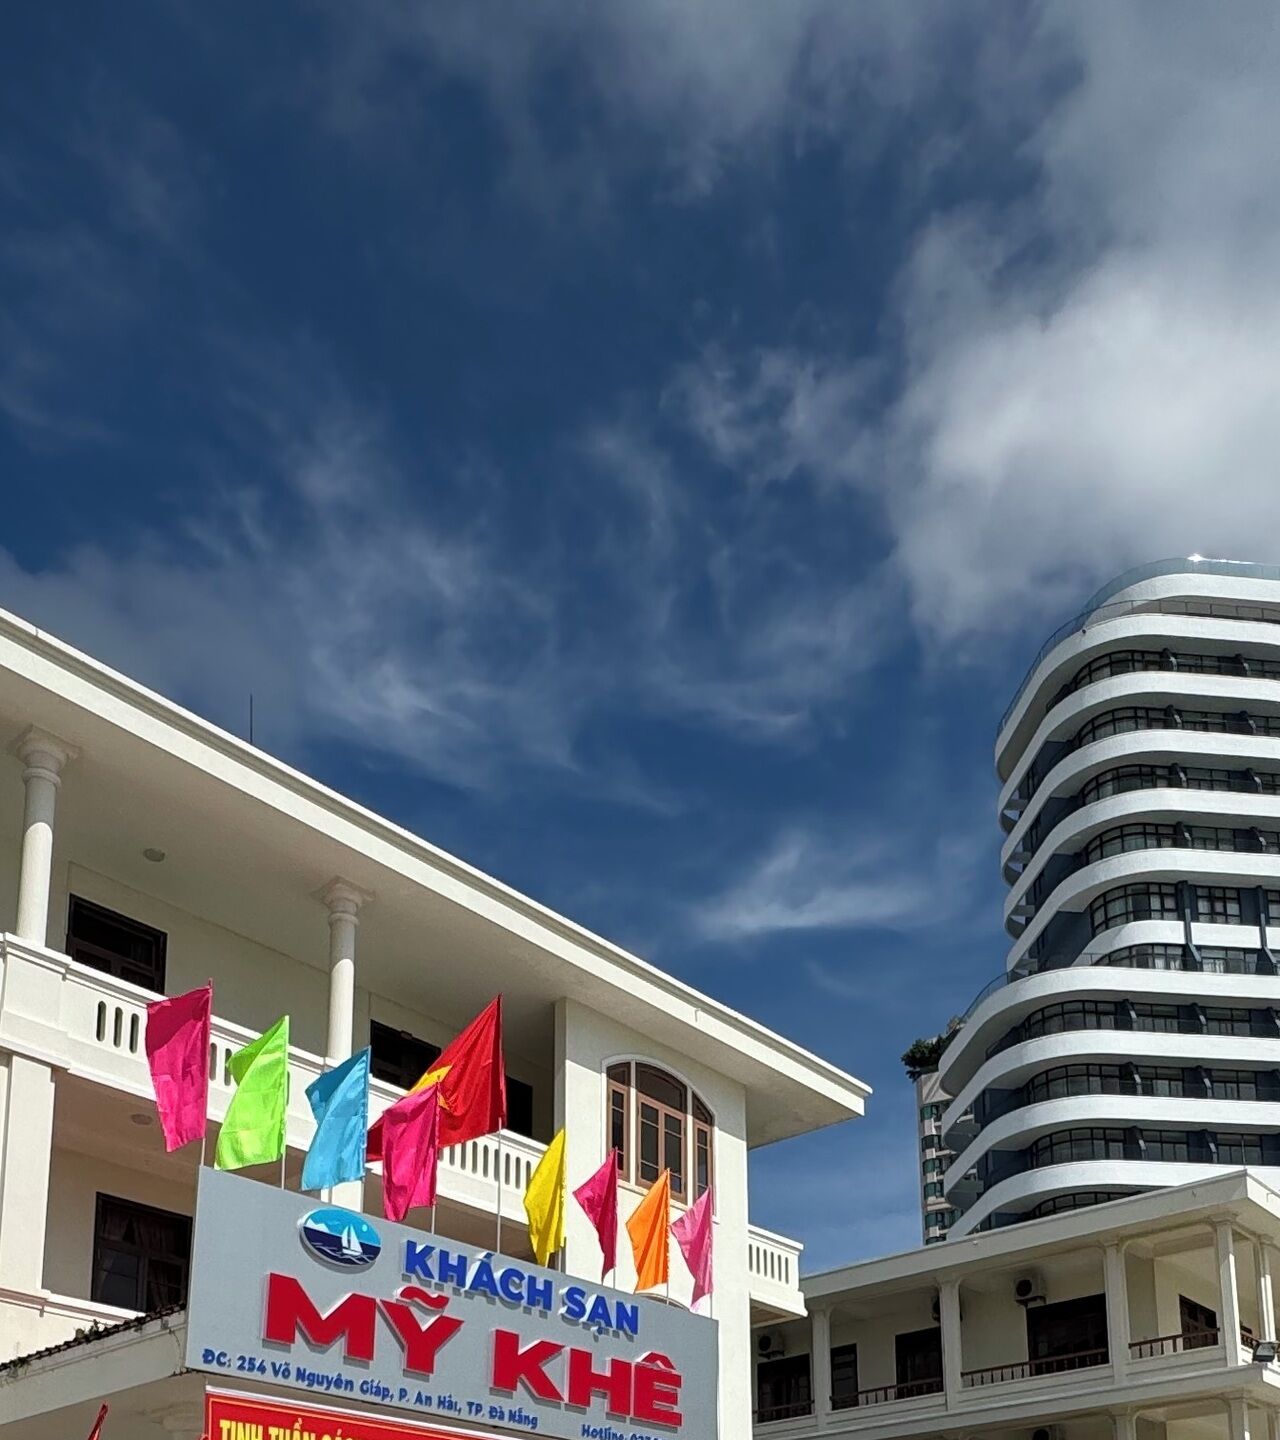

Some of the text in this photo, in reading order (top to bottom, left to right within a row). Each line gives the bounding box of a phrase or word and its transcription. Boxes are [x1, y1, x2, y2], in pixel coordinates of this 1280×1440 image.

[404, 1239, 639, 1337] KHÁCH SẠN
[202, 1349, 232, 1368] ĐC:
[237, 1355, 266, 1375] 254
[271, 1361, 291, 1379] Võ
[295, 1367, 354, 1391] Nguyên
[360, 1379, 394, 1401] Giáp,
[399, 1387, 410, 1402] P.
[414, 1391, 432, 1407] An
[467, 1401, 485, 1417] TP.
[488, 1405, 505, 1421] Đà
[508, 1407, 539, 1429] Nẵng
[263, 1272, 683, 1428] MỸ KHÊ
